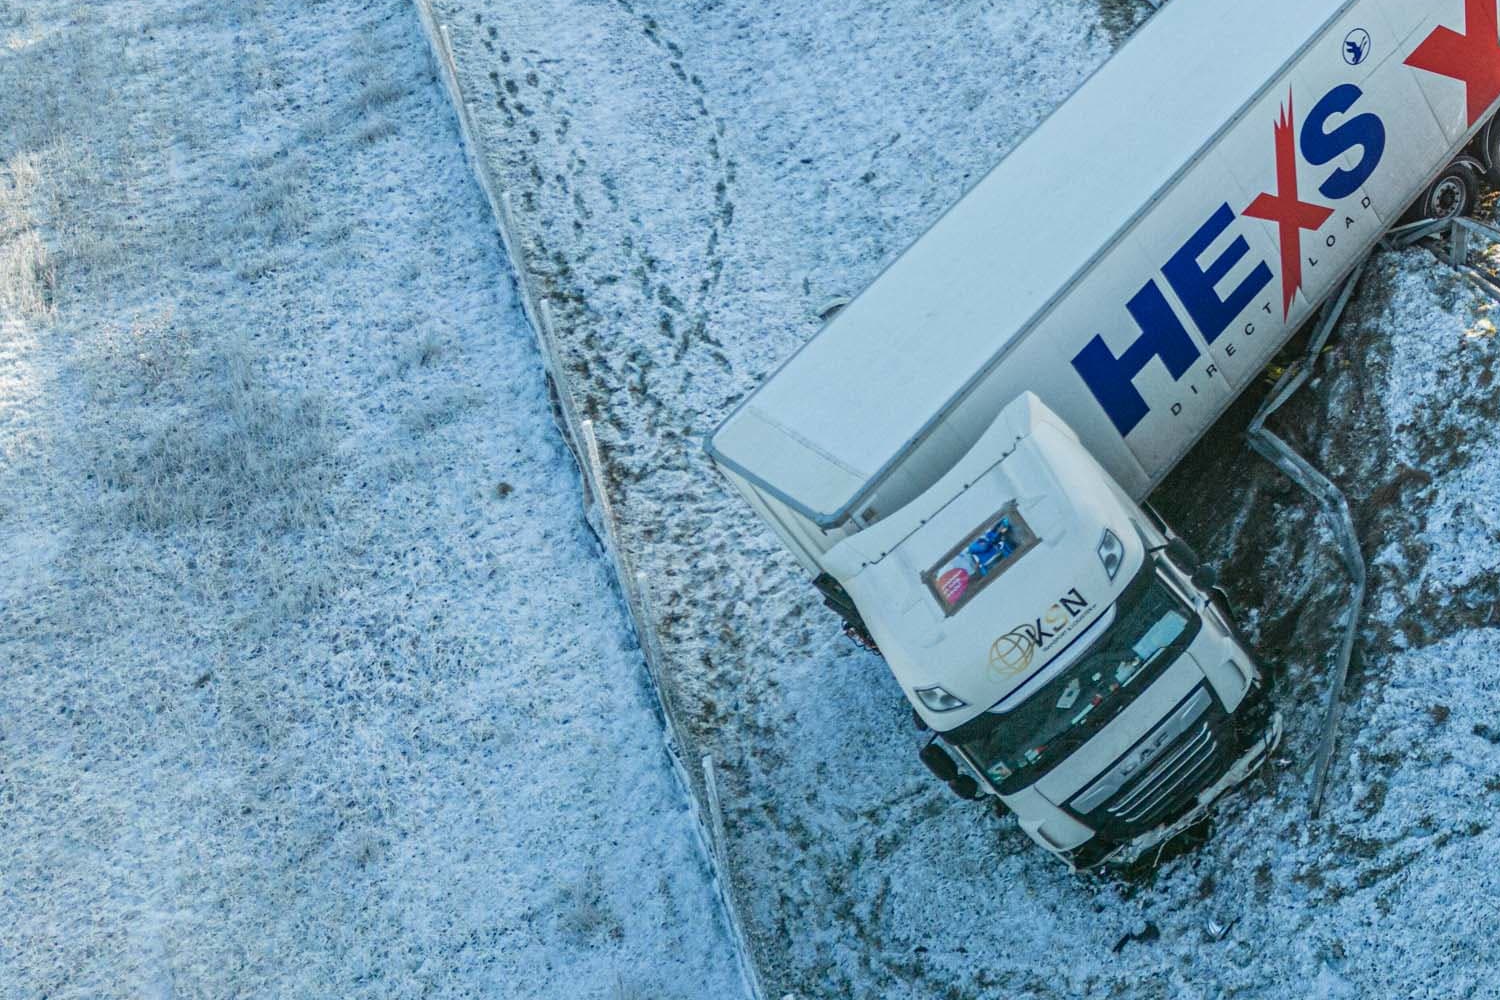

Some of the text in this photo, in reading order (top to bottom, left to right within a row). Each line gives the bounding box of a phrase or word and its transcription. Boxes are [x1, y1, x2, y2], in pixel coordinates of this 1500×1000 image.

[1070, 83, 1386, 439] HEXS
[1170, 196, 1372, 417] DIRECT LOAD
[1119, 731, 1169, 777] DAF
